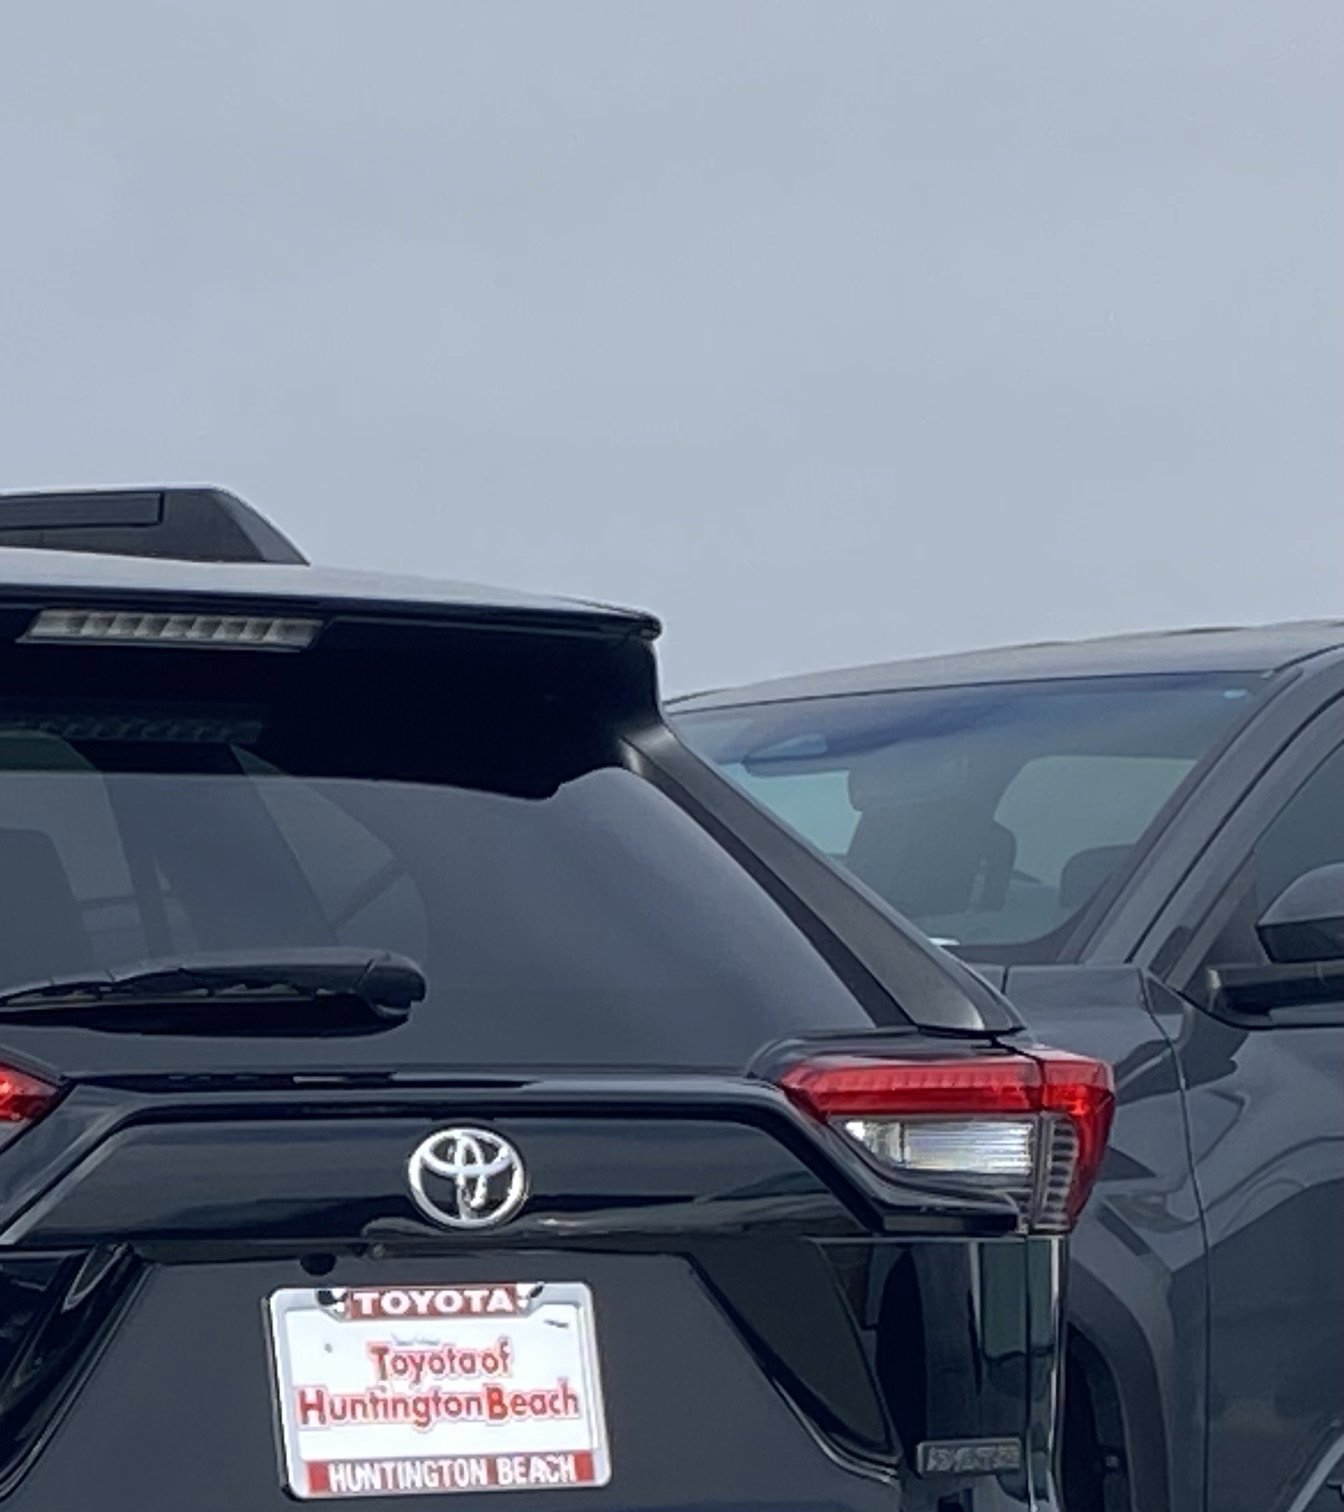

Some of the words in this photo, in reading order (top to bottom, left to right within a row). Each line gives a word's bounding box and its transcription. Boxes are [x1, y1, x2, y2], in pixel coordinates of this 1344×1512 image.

[354, 1289, 514, 1315] TOYOTA
[329, 1459, 487, 1493] HUNTINGTON
[498, 1453, 575, 1485] BEACH
